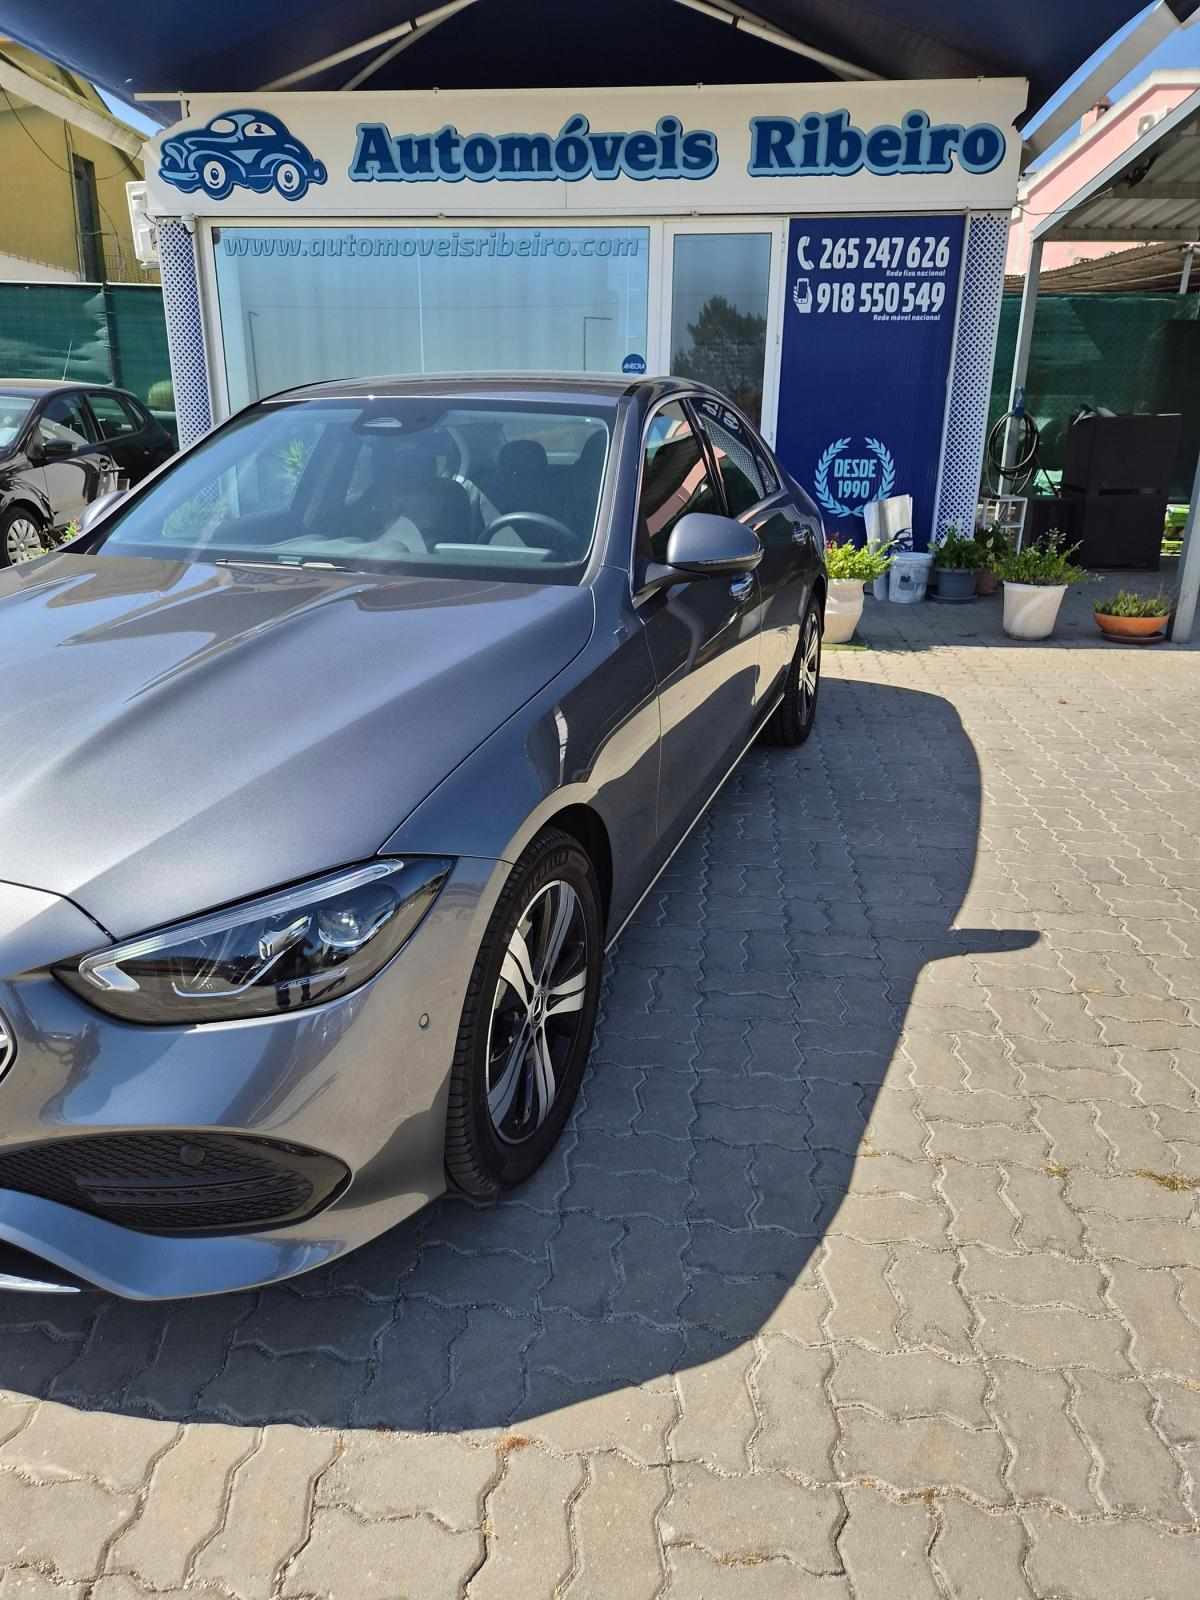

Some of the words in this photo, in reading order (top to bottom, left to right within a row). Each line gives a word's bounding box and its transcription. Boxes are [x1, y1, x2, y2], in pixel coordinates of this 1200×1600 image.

[350, 114, 717, 181] Automóveis
[749, 110, 1004, 176] Ribeiro
[223, 232, 639, 257] www.automoveisribeiro.com
[819, 237, 860, 269] 265
[863, 237, 905, 269] 247
[906, 236, 950, 268] 626
[816, 282, 856, 313] 918
[859, 282, 900, 313] 550
[902, 282, 946, 313] 549
[834, 459, 878, 478] DESDE
[837, 480, 871, 499] 1990
